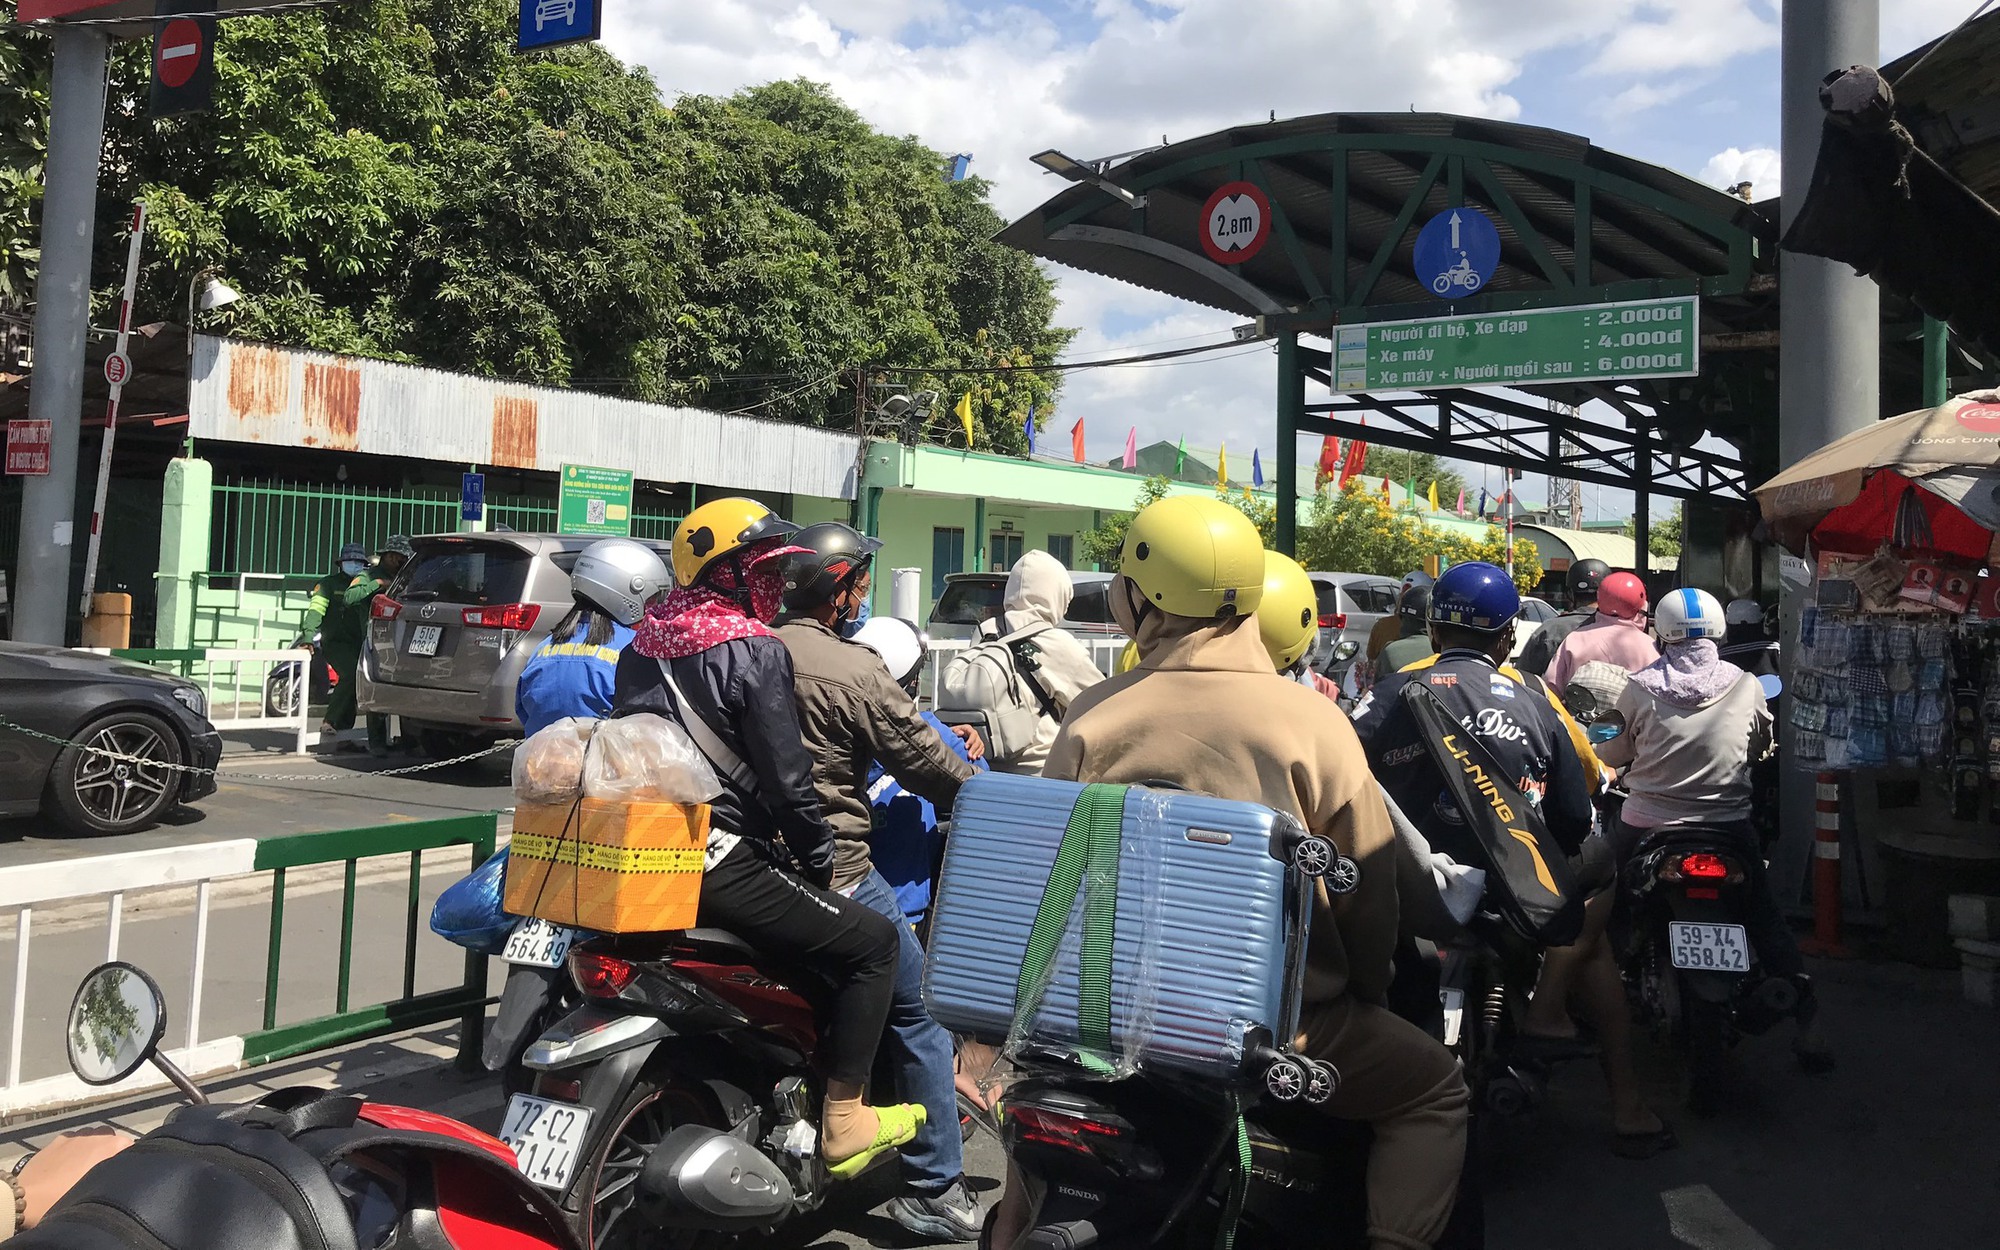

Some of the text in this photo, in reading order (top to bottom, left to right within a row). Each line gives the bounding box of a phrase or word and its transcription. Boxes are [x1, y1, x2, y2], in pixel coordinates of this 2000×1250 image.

[1217, 214, 1252, 237] 2,8m
[1381, 327, 1423, 343] Người
[1447, 321, 1470, 340] bộ,
[1474, 321, 1495, 336] Xe
[1499, 319, 1528, 336] đạp
[1598, 306, 1683, 326] 2.000đ
[1380, 350, 1399, 364] Xe
[1403, 348, 1435, 363] máy
[1598, 329, 1683, 348] 4.000đ
[109, 357, 122, 382] STOP
[1380, 371, 1399, 384] Xe
[1403, 370, 1434, 384] máy
[1454, 365, 1499, 381] Người
[1504, 361, 1539, 378] ngồi
[1543, 361, 1573, 375] sau
[1598, 353, 1682, 371] 6.000đ
[1440, 603, 1475, 613] VINFAST
[1443, 735, 1515, 823] LI-NING
[507, 936, 566, 963] 564.89
[1680, 926, 1736, 948] 59-X4
[1677, 946, 1744, 969] 558.42
[513, 1101, 575, 1144] 72-C2
[502, 1136, 570, 1184] 71.44
[1058, 1186, 1101, 1202] HONDA
